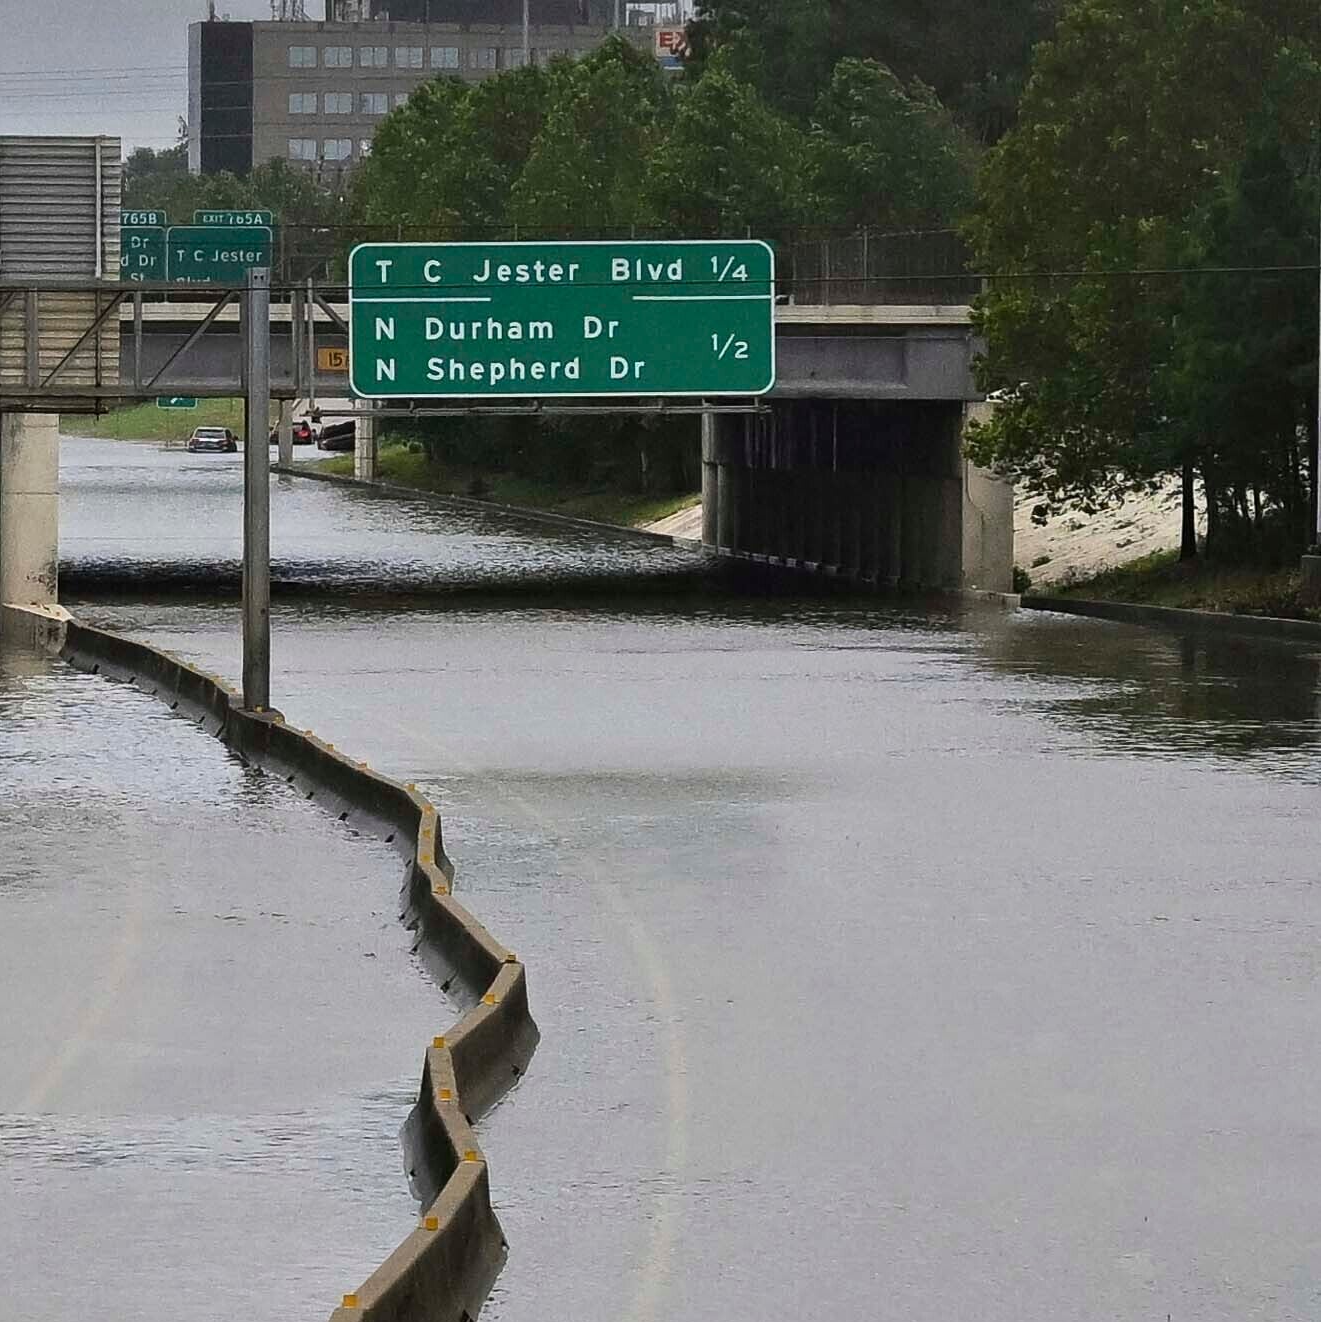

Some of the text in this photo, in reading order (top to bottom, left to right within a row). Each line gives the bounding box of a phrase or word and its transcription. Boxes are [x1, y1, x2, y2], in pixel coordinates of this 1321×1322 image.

[122, 213, 158, 225] 765B
[202, 213, 263, 225] EXIT 765A
[131, 236, 150, 249] Dr
[138, 254, 157, 267] Dr
[176, 250, 263, 262] T C Jester
[376, 260, 393, 283] T
[423, 260, 443, 283] C
[473, 259, 580, 283] Jester
[611, 258, 684, 282] Blvd
[376, 316, 620, 341] N Durham Dr
[376, 358, 396, 382] N
[426, 357, 581, 386] Shepherd
[610, 356, 646, 380] Dr
